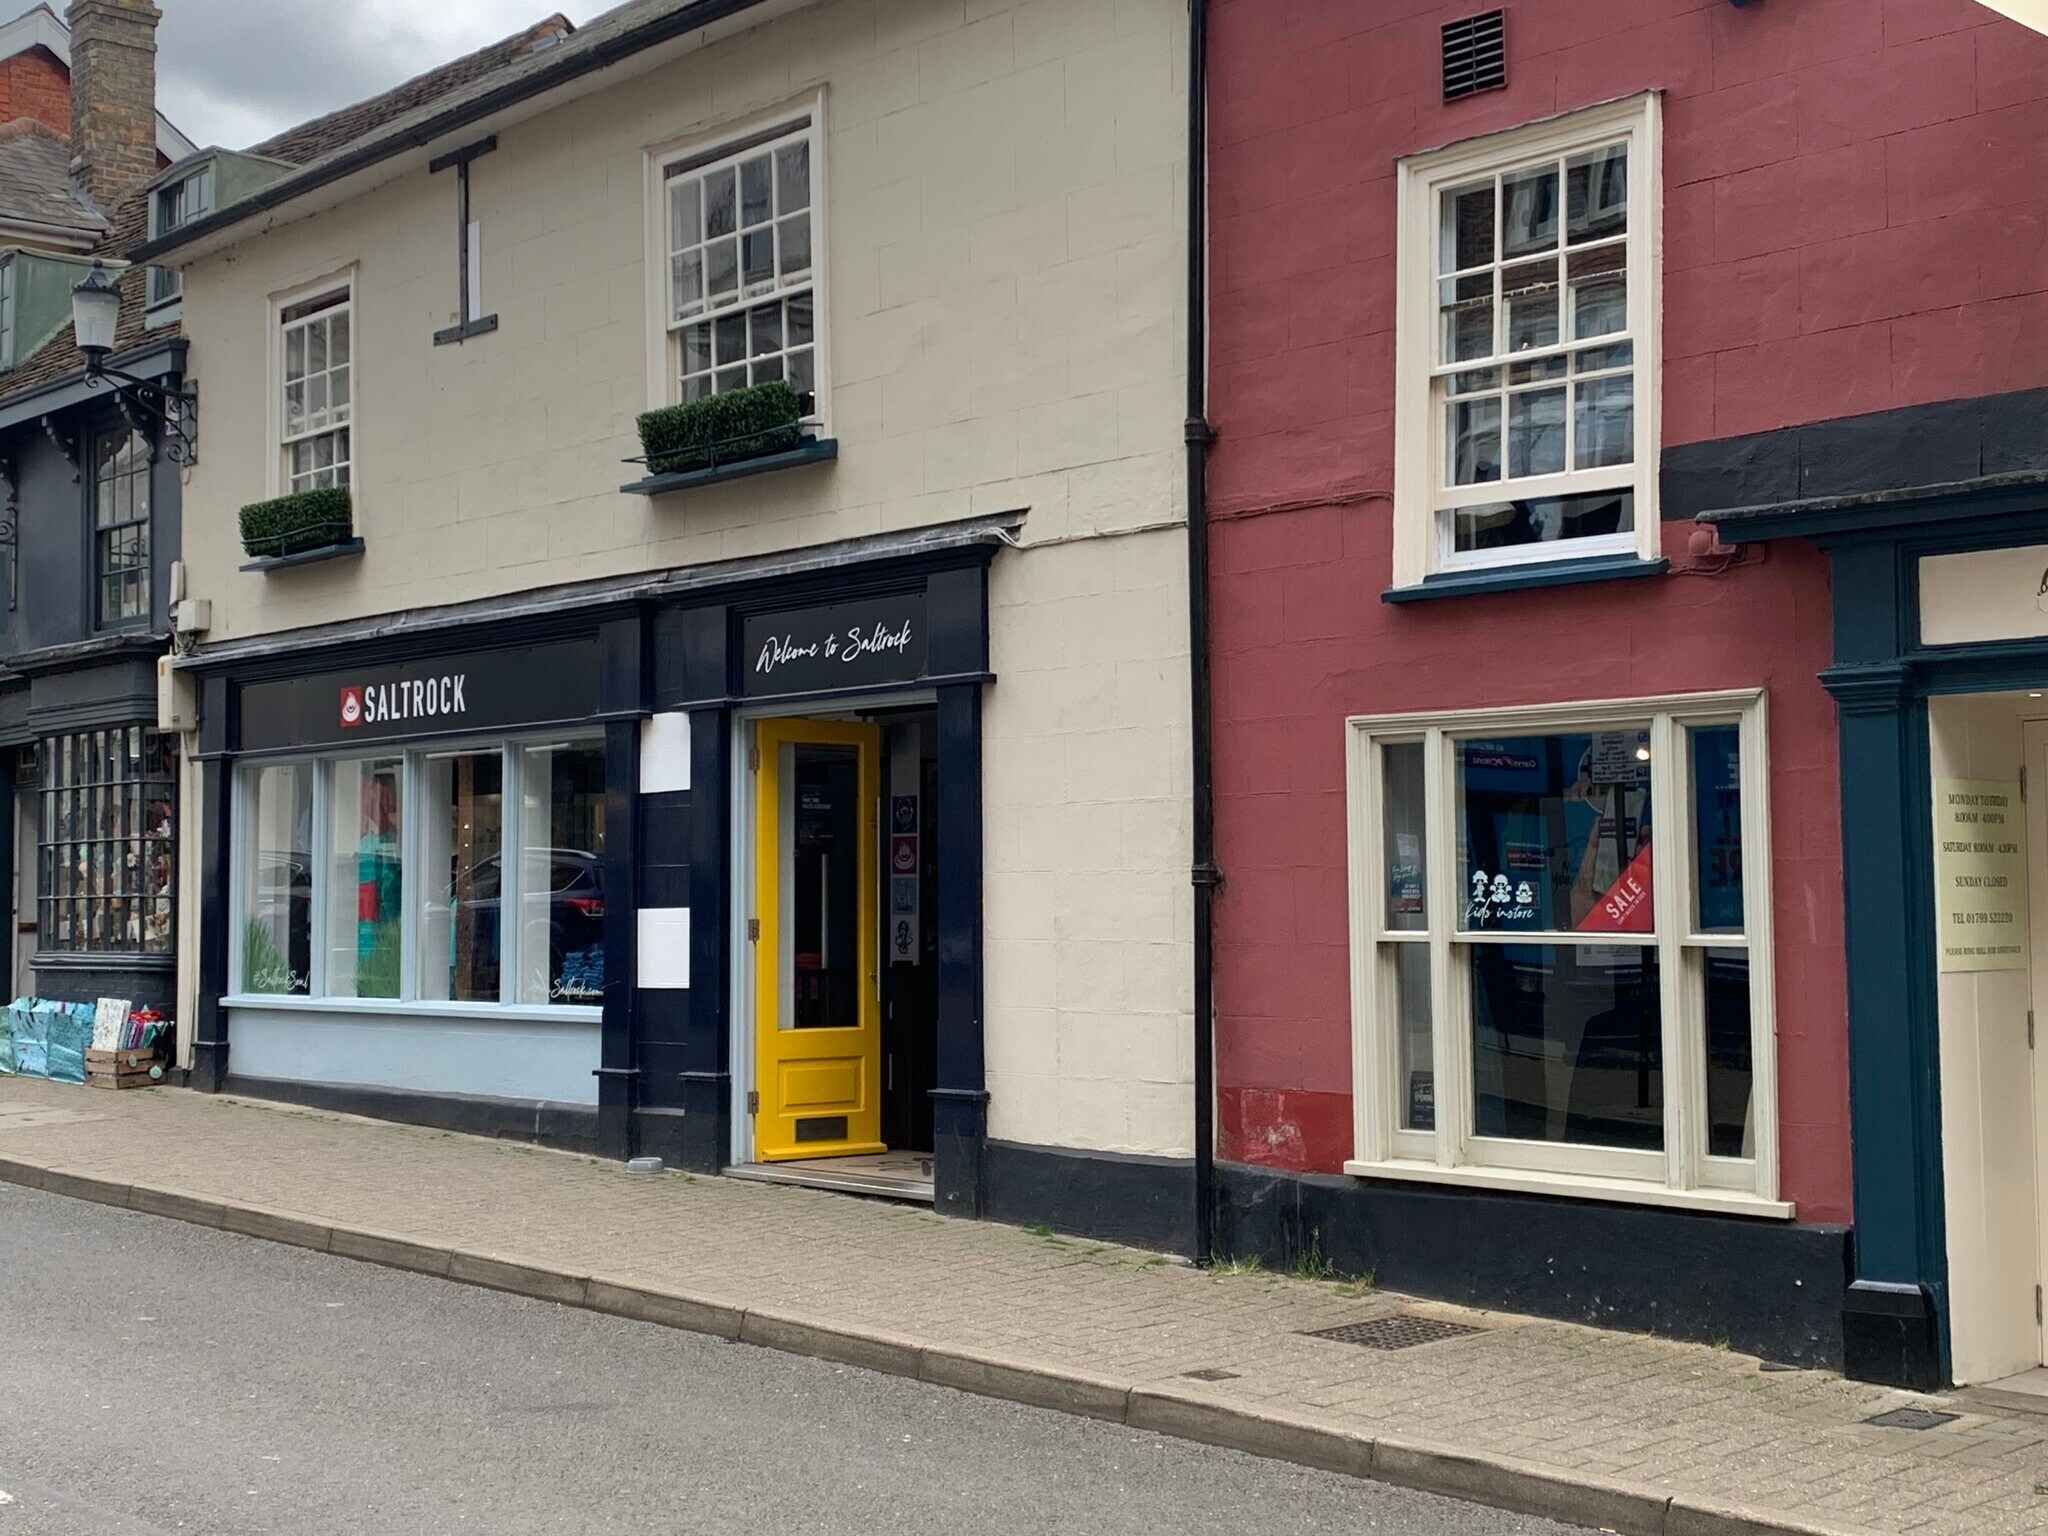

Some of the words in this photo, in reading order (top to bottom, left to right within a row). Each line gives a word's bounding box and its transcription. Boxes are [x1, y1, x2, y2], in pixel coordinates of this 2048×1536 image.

[755, 634, 819, 673] Welcome
[824, 633, 840, 658] to
[841, 619, 912, 662] Saltrock
[364, 674, 466, 723] SALTROCK
[1948, 794, 1979, 806] MONDAY
[1942, 842, 1972, 853] SATURDAY
[1955, 876, 1982, 887] SUNDAY
[1983, 876, 2008, 887] CLOSED
[1605, 876, 1642, 919] SALE
[1464, 897, 1493, 926] Kids
[1496, 903, 1535, 919] instore
[1952, 912, 1965, 924] TEL
